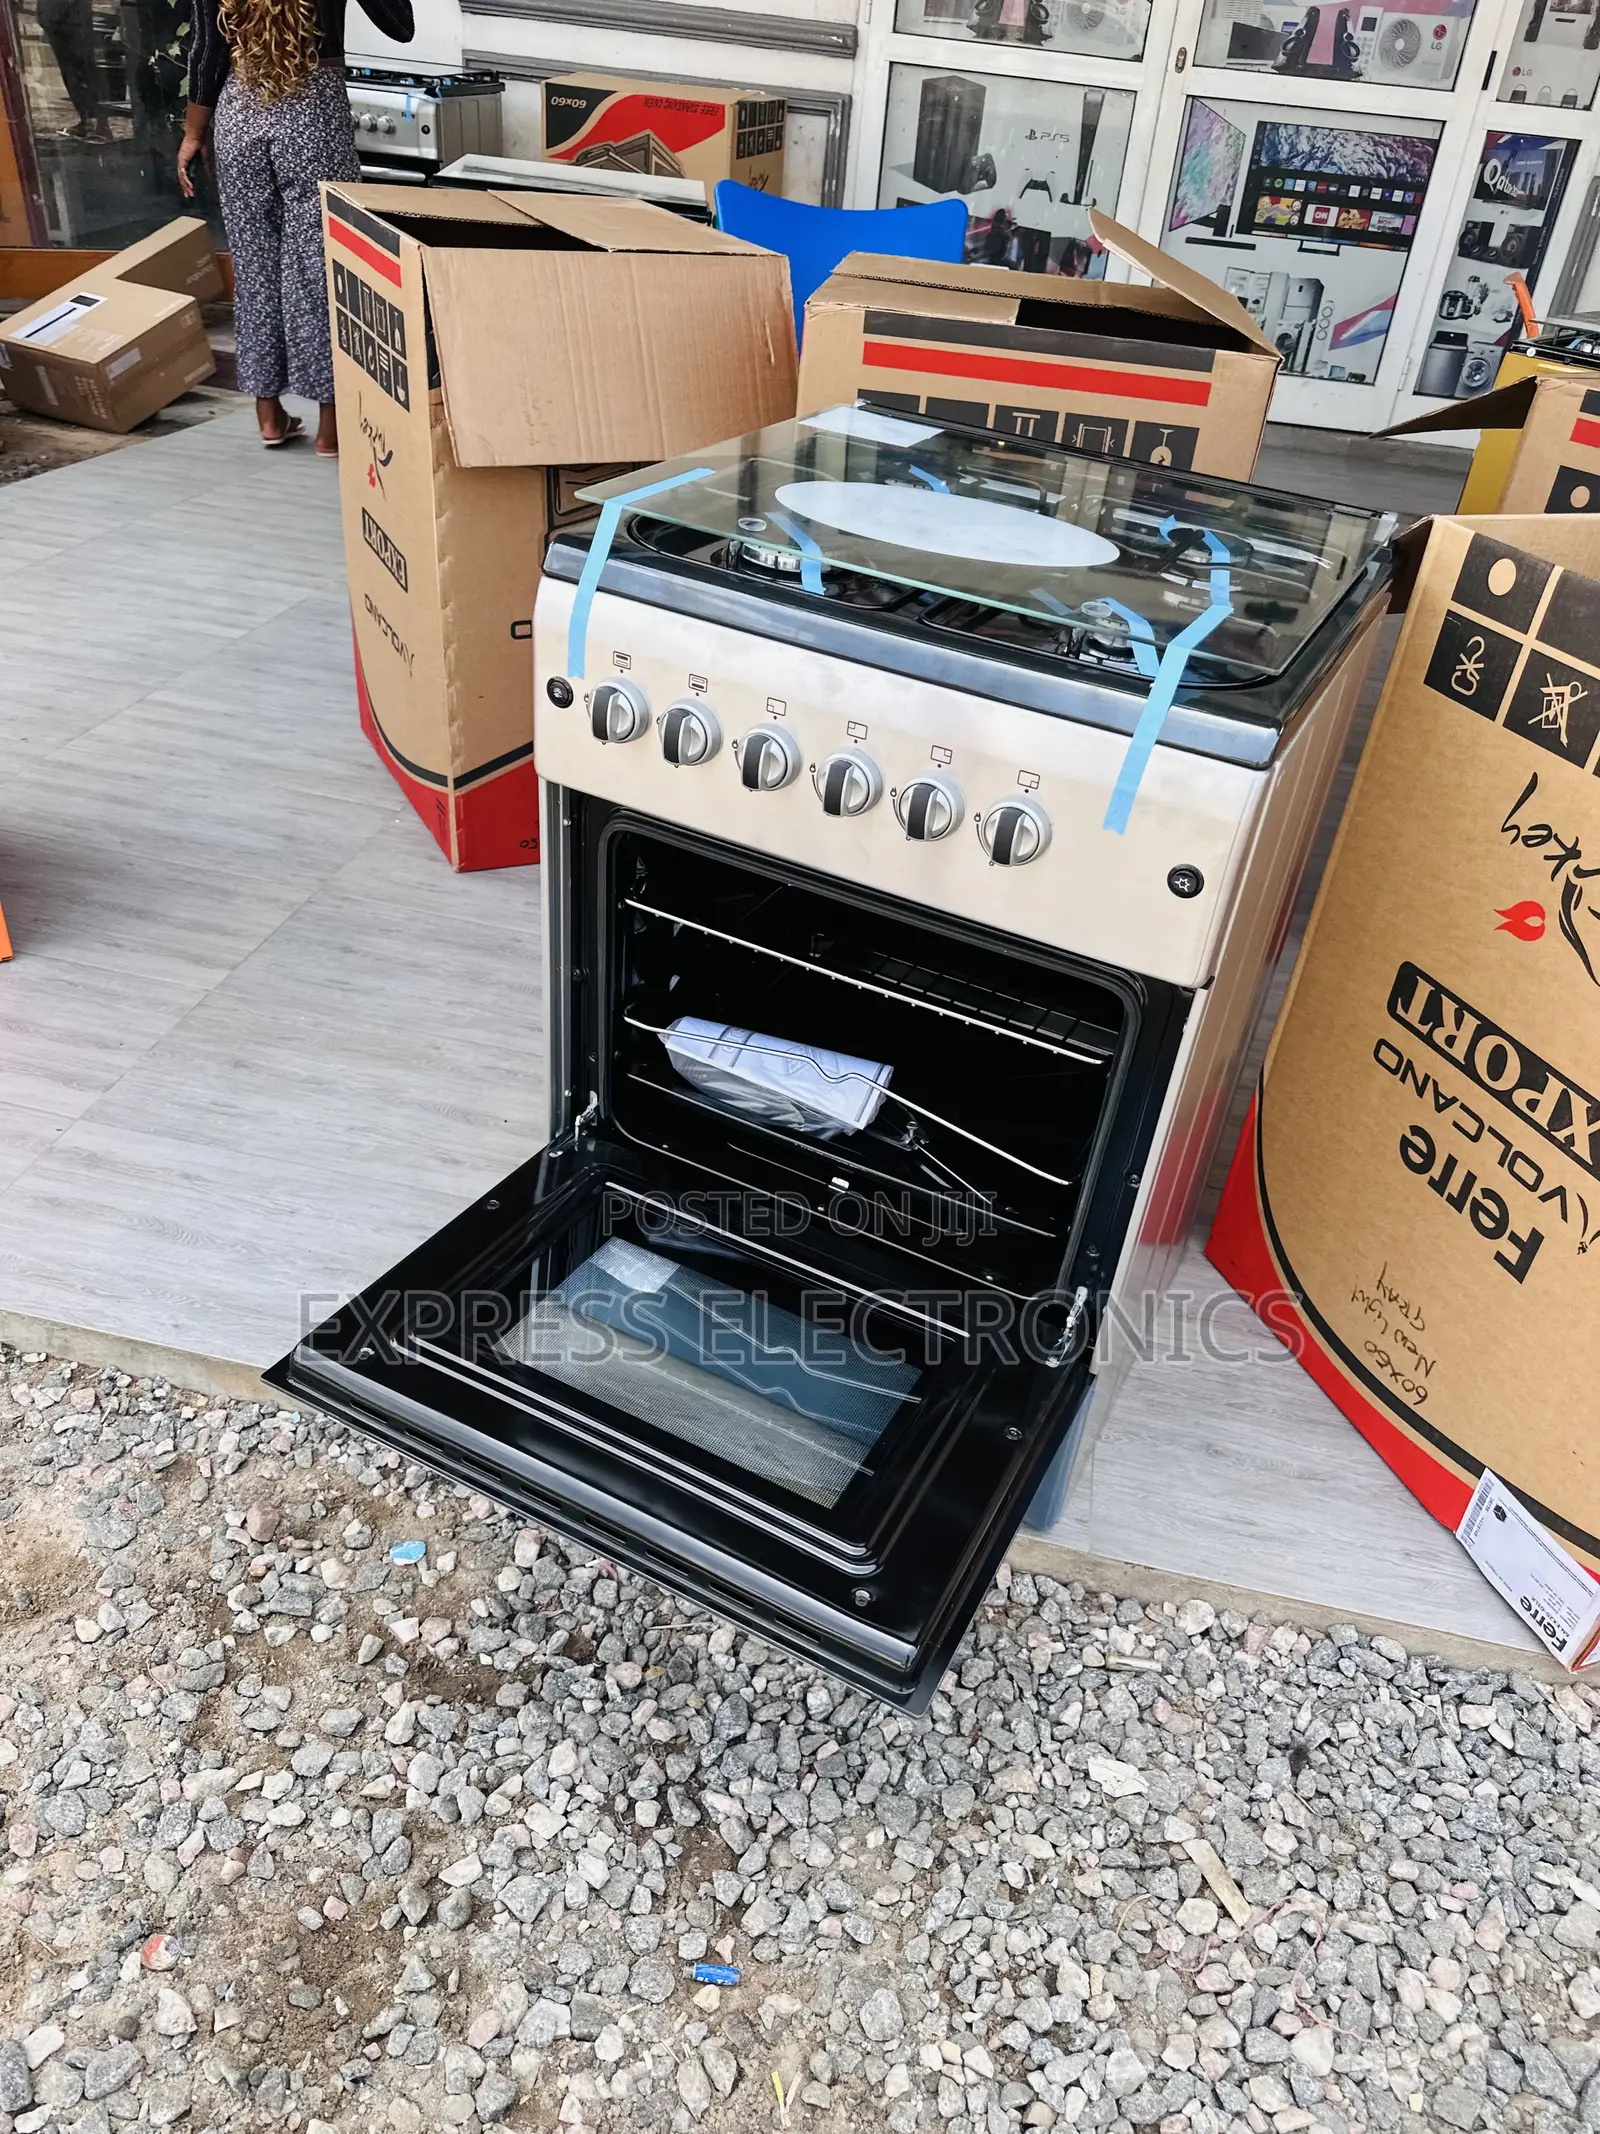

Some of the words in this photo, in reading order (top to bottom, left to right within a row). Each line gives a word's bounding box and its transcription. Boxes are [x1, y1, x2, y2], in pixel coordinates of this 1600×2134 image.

[1431, 42, 1442, 50] LG
[1522, 68, 1533, 77] LG
[551, 96, 587, 109] 60x60
[1040, 132, 1070, 143] PS5
[363, 512, 407, 588] EXPORT
[364, 592, 409, 664] VOLCANO
[1396, 975, 1600, 1170] XPORT
[1373, 1038, 1568, 1224] VOLCANO
[1399, 1124, 1545, 1285] Ferre
[1519, 1595, 1569, 1653] Ferre
